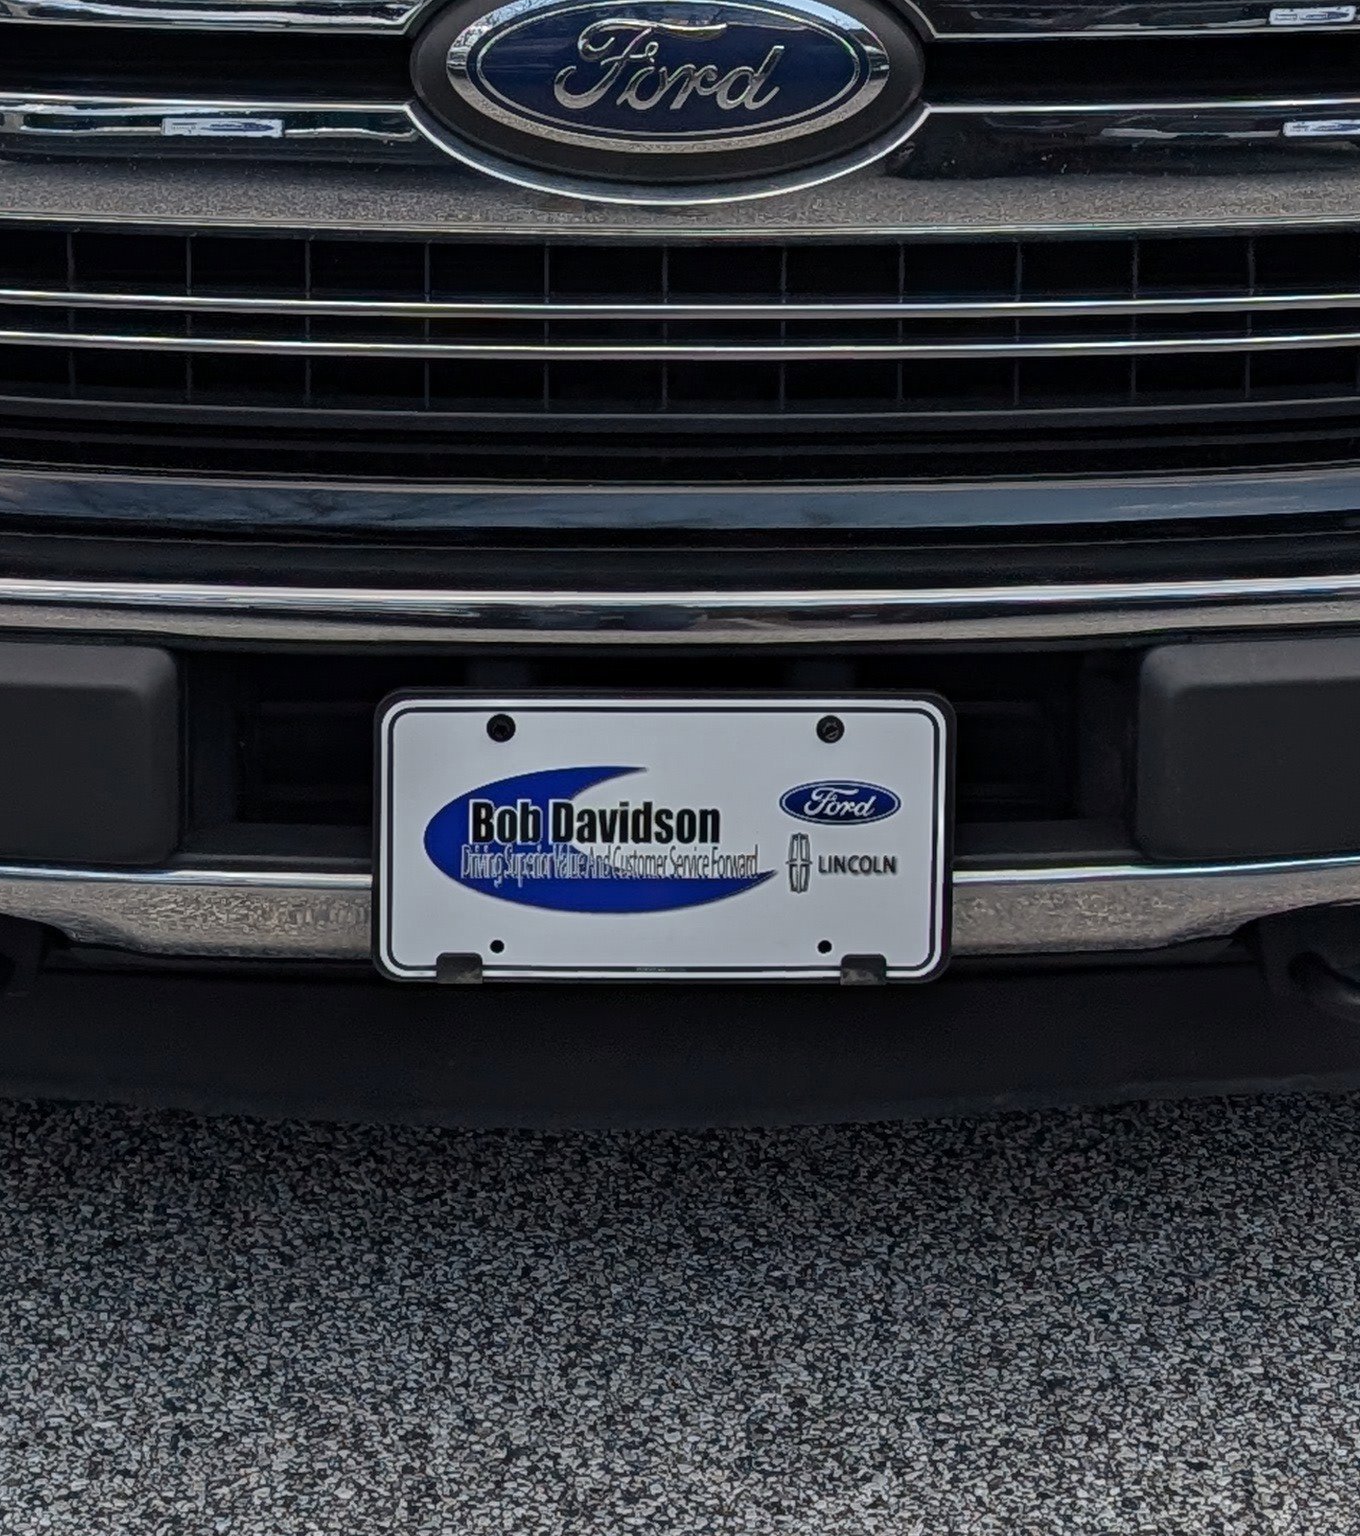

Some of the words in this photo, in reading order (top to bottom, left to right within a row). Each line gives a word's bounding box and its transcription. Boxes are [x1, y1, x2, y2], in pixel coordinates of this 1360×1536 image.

[554, 17, 786, 111] Ford
[469, 798, 542, 844] Bob
[549, 798, 721, 845] Davidson
[803, 786, 877, 817] Ford
[461, 844, 503, 888] Driving
[503, 844, 552, 888] Superior
[552, 843, 587, 879] Value
[586, 844, 612, 879] And
[612, 845, 668, 880] Customer
[669, 845, 710, 879] Service
[710, 844, 759, 879] Forward
[817, 854, 897, 876] LINCOLN
